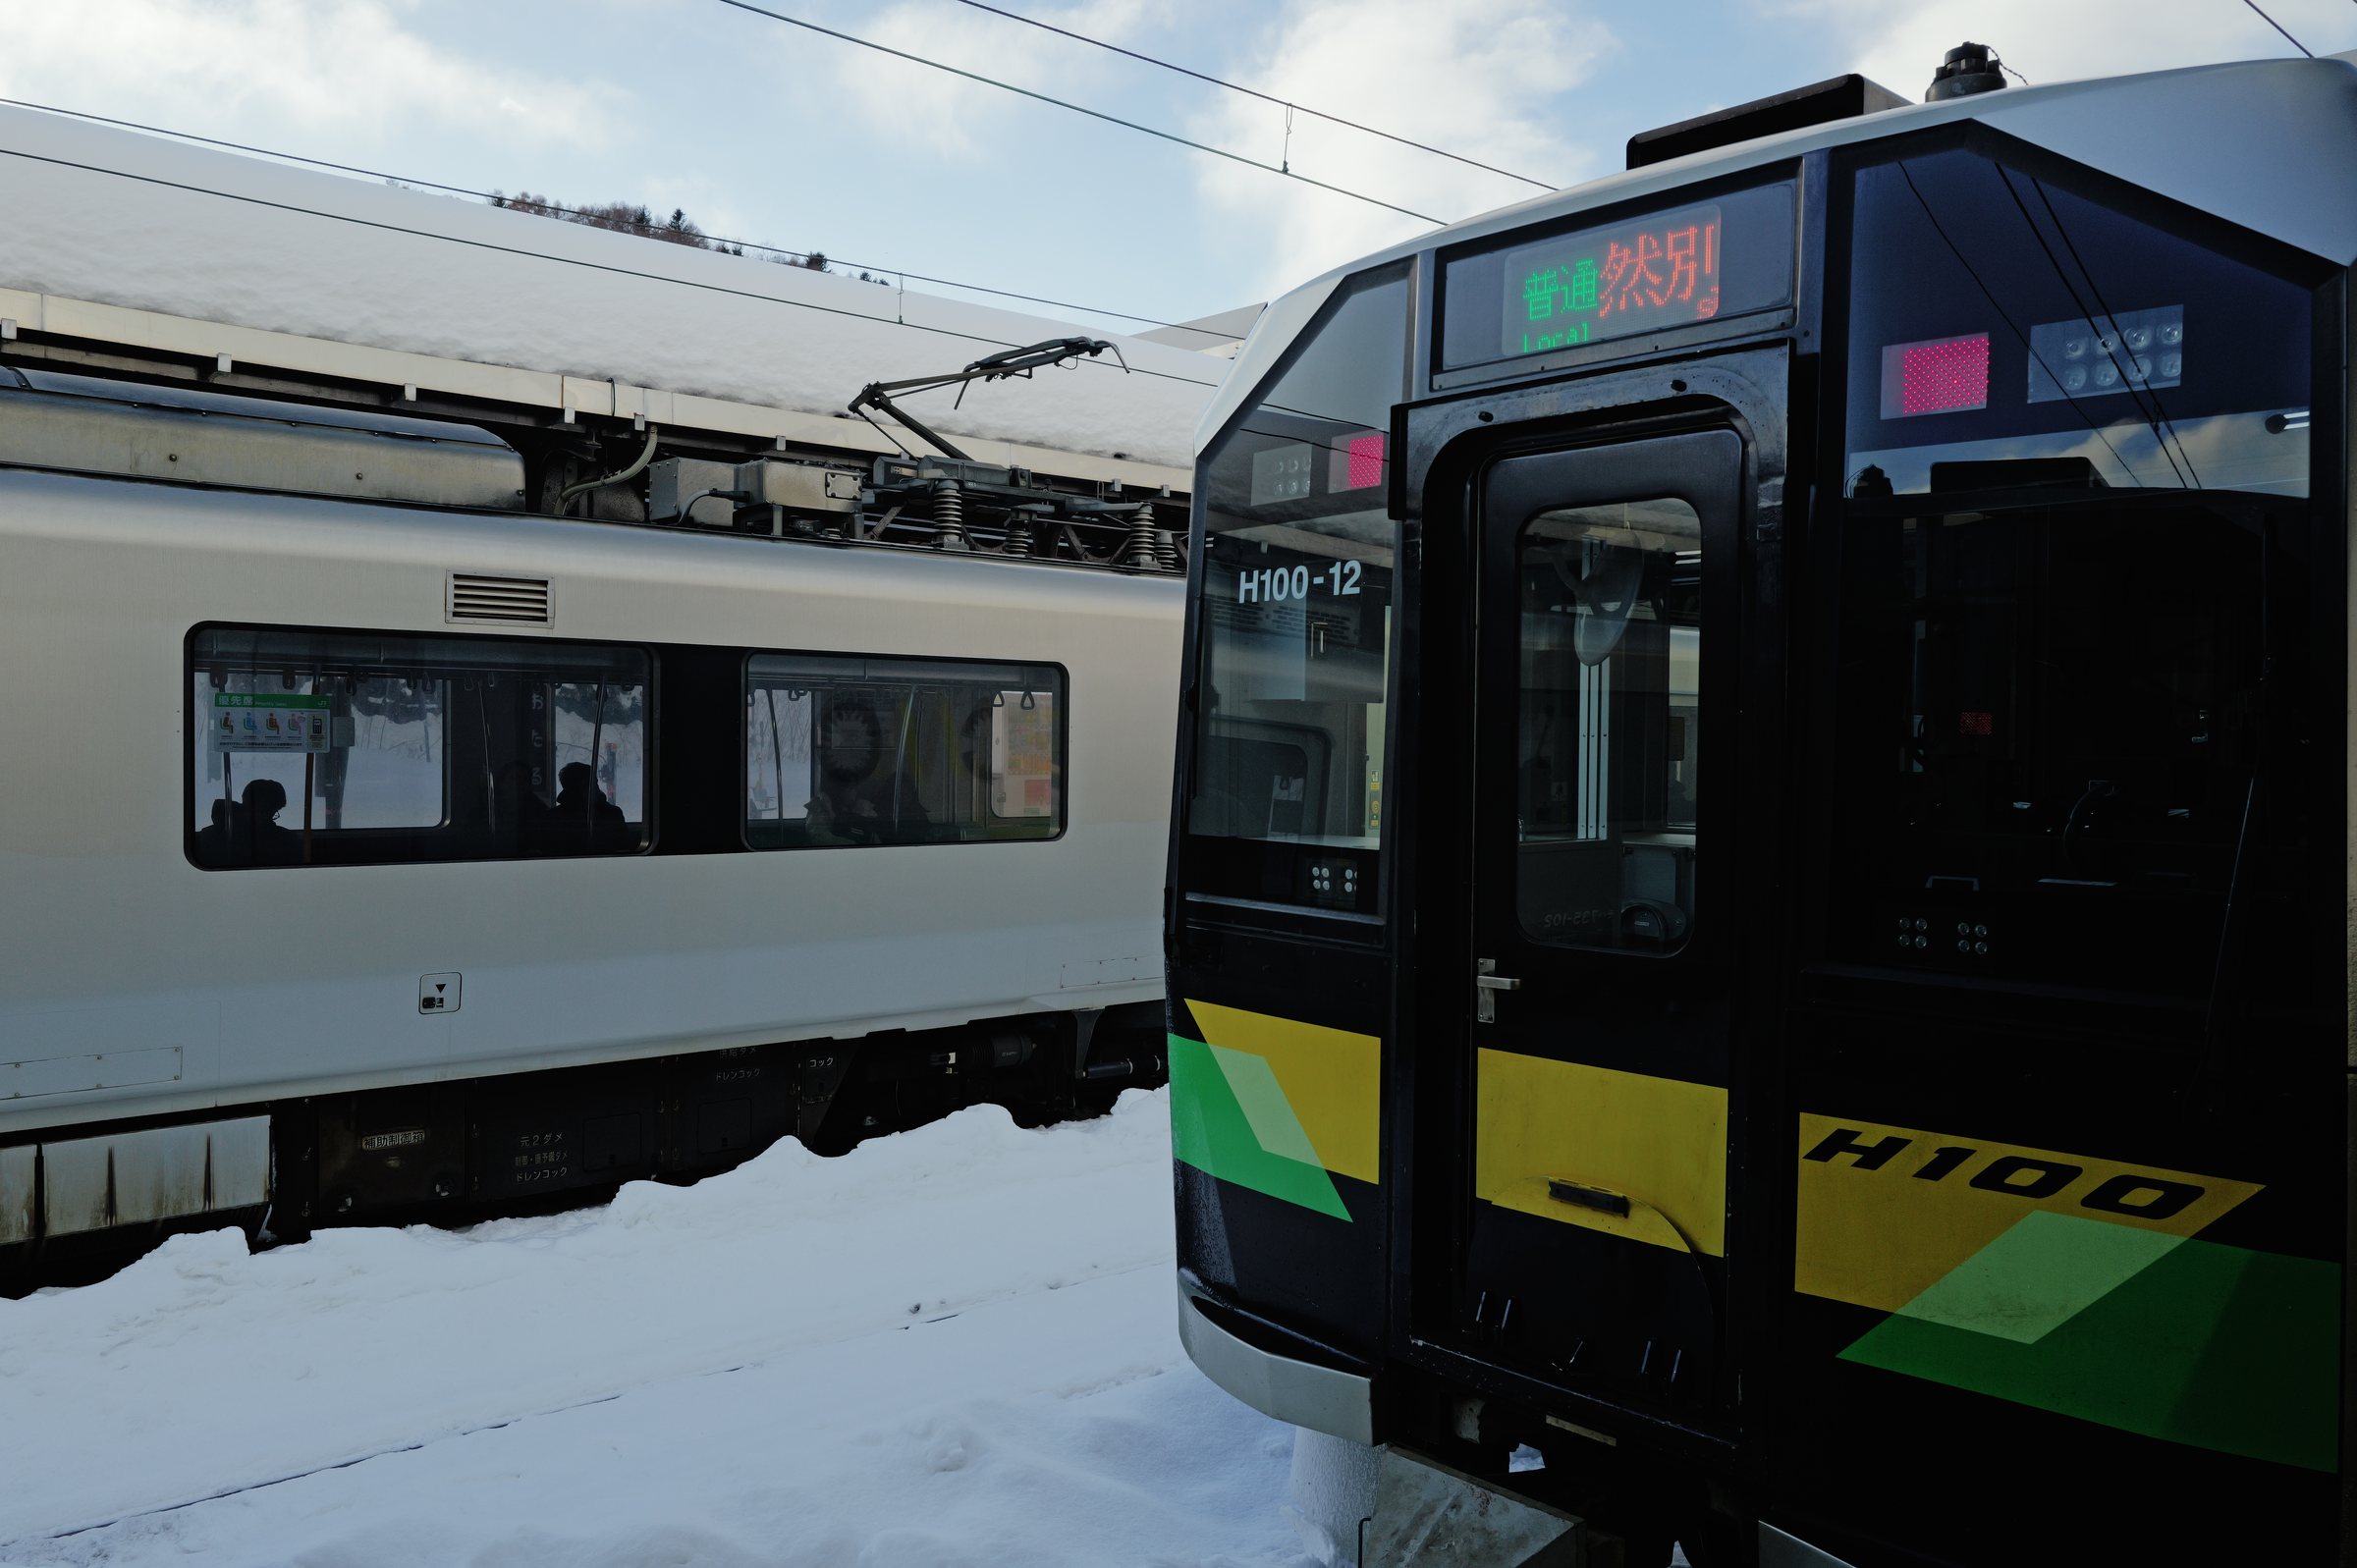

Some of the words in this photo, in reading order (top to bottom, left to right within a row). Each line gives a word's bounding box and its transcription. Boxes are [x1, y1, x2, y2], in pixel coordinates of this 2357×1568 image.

[1522, 258, 1598, 321] 普通
[1599, 224, 1715, 318] 然別
[1238, 560, 1362, 604] H100-12
[809, 1056, 834, 1068] コック
[716, 1068, 761, 1082] ドレンコック
[363, 1131, 424, 1150] 補助制御箱
[517, 1166, 568, 1182] ドレンコック
[1803, 1128, 2206, 1219] H100
